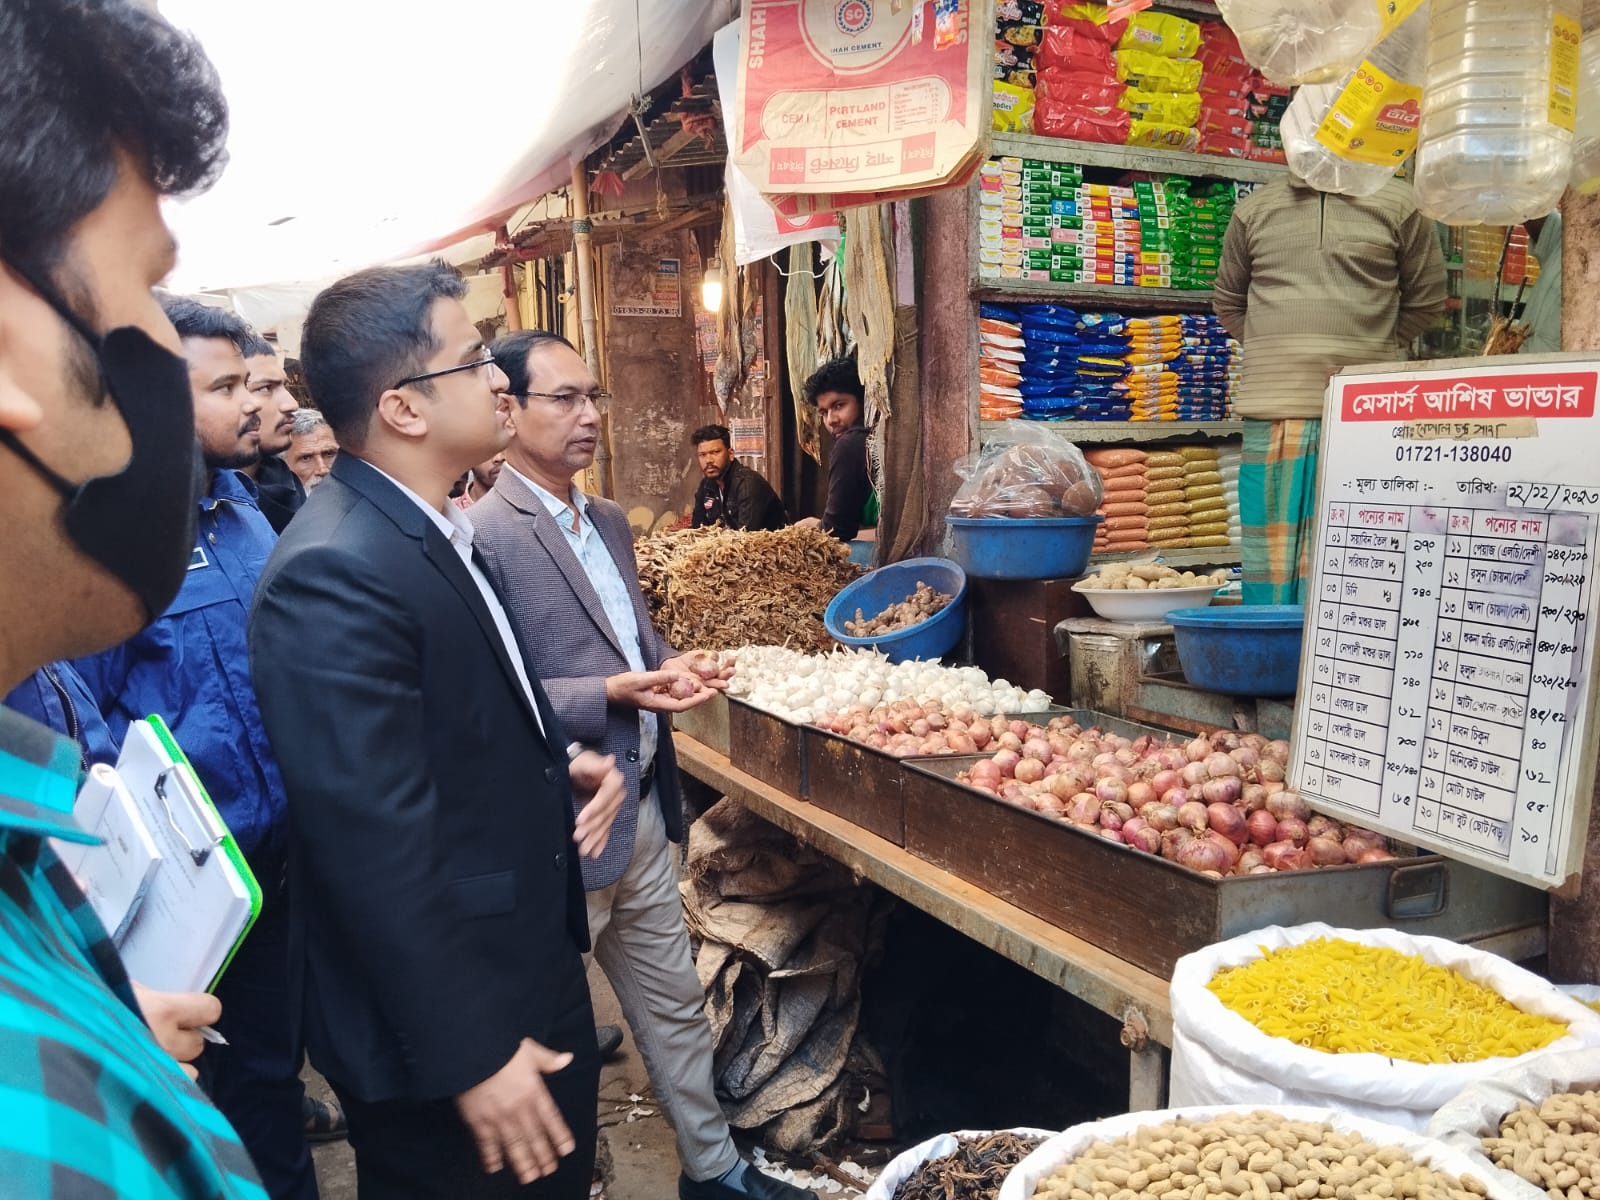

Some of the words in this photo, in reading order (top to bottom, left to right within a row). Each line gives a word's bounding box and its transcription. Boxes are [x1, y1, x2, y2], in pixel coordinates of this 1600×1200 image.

[747, 10, 767, 70] SHAH
[831, 44, 849, 54] HAH
[851, 42, 882, 52] CEMENT
[836, 117, 878, 129] CEMENT
[1352, 385, 1419, 414] মেসার্স
[1423, 382, 1496, 413] আশিষ
[1503, 383, 1584, 411] ভান্ডার
[1395, 445, 1512, 462] 01721-138040
[1356, 478, 1378, 494] মূল্য
[1380, 475, 1419, 492] তালিকা
[1387, 511, 1405, 525] নাম
[1521, 520, 1543, 536] নাম
[1331, 532, 1341, 543] ০১
[1451, 541, 1461, 554] ১১
[1329, 557, 1339, 569] ০২
[1448, 571, 1459, 584] ১২
[1470, 568, 1488, 584] রসুন
[1326, 584, 1337, 593] ০৩
[1345, 582, 1358, 597] চিনি
[1467, 600, 1485, 614] আদা
[1324, 610, 1334, 620] ০৪
[1374, 618, 1387, 631] ডাল
[1321, 637, 1332, 647] ০৫
[1441, 631, 1452, 643] ১৪
[1378, 649, 1391, 662] ডাল
[1319, 664, 1329, 674] ০৬
[1438, 659, 1449, 672] ১৫
[1348, 673, 1361, 685] ডাল
[1315, 693, 1326, 704] ০৭
[1356, 702, 1369, 716] ডাল
[1313, 721, 1323, 732] ০৮
[1431, 717, 1442, 731] ১৭
[1354, 728, 1367, 741] ডাল
[1531, 738, 1547, 750] ৪০
[1428, 747, 1439, 759] ১৮
[1358, 756, 1371, 770] ডাল
[1449, 749, 1479, 770] মিনিকেট
[1481, 760, 1500, 777] চাউল
[1307, 775, 1317, 786] ১০
[1446, 781, 1464, 797] মোটা
[1466, 787, 1486, 803] চাউল
[1421, 806, 1432, 818] ২০
